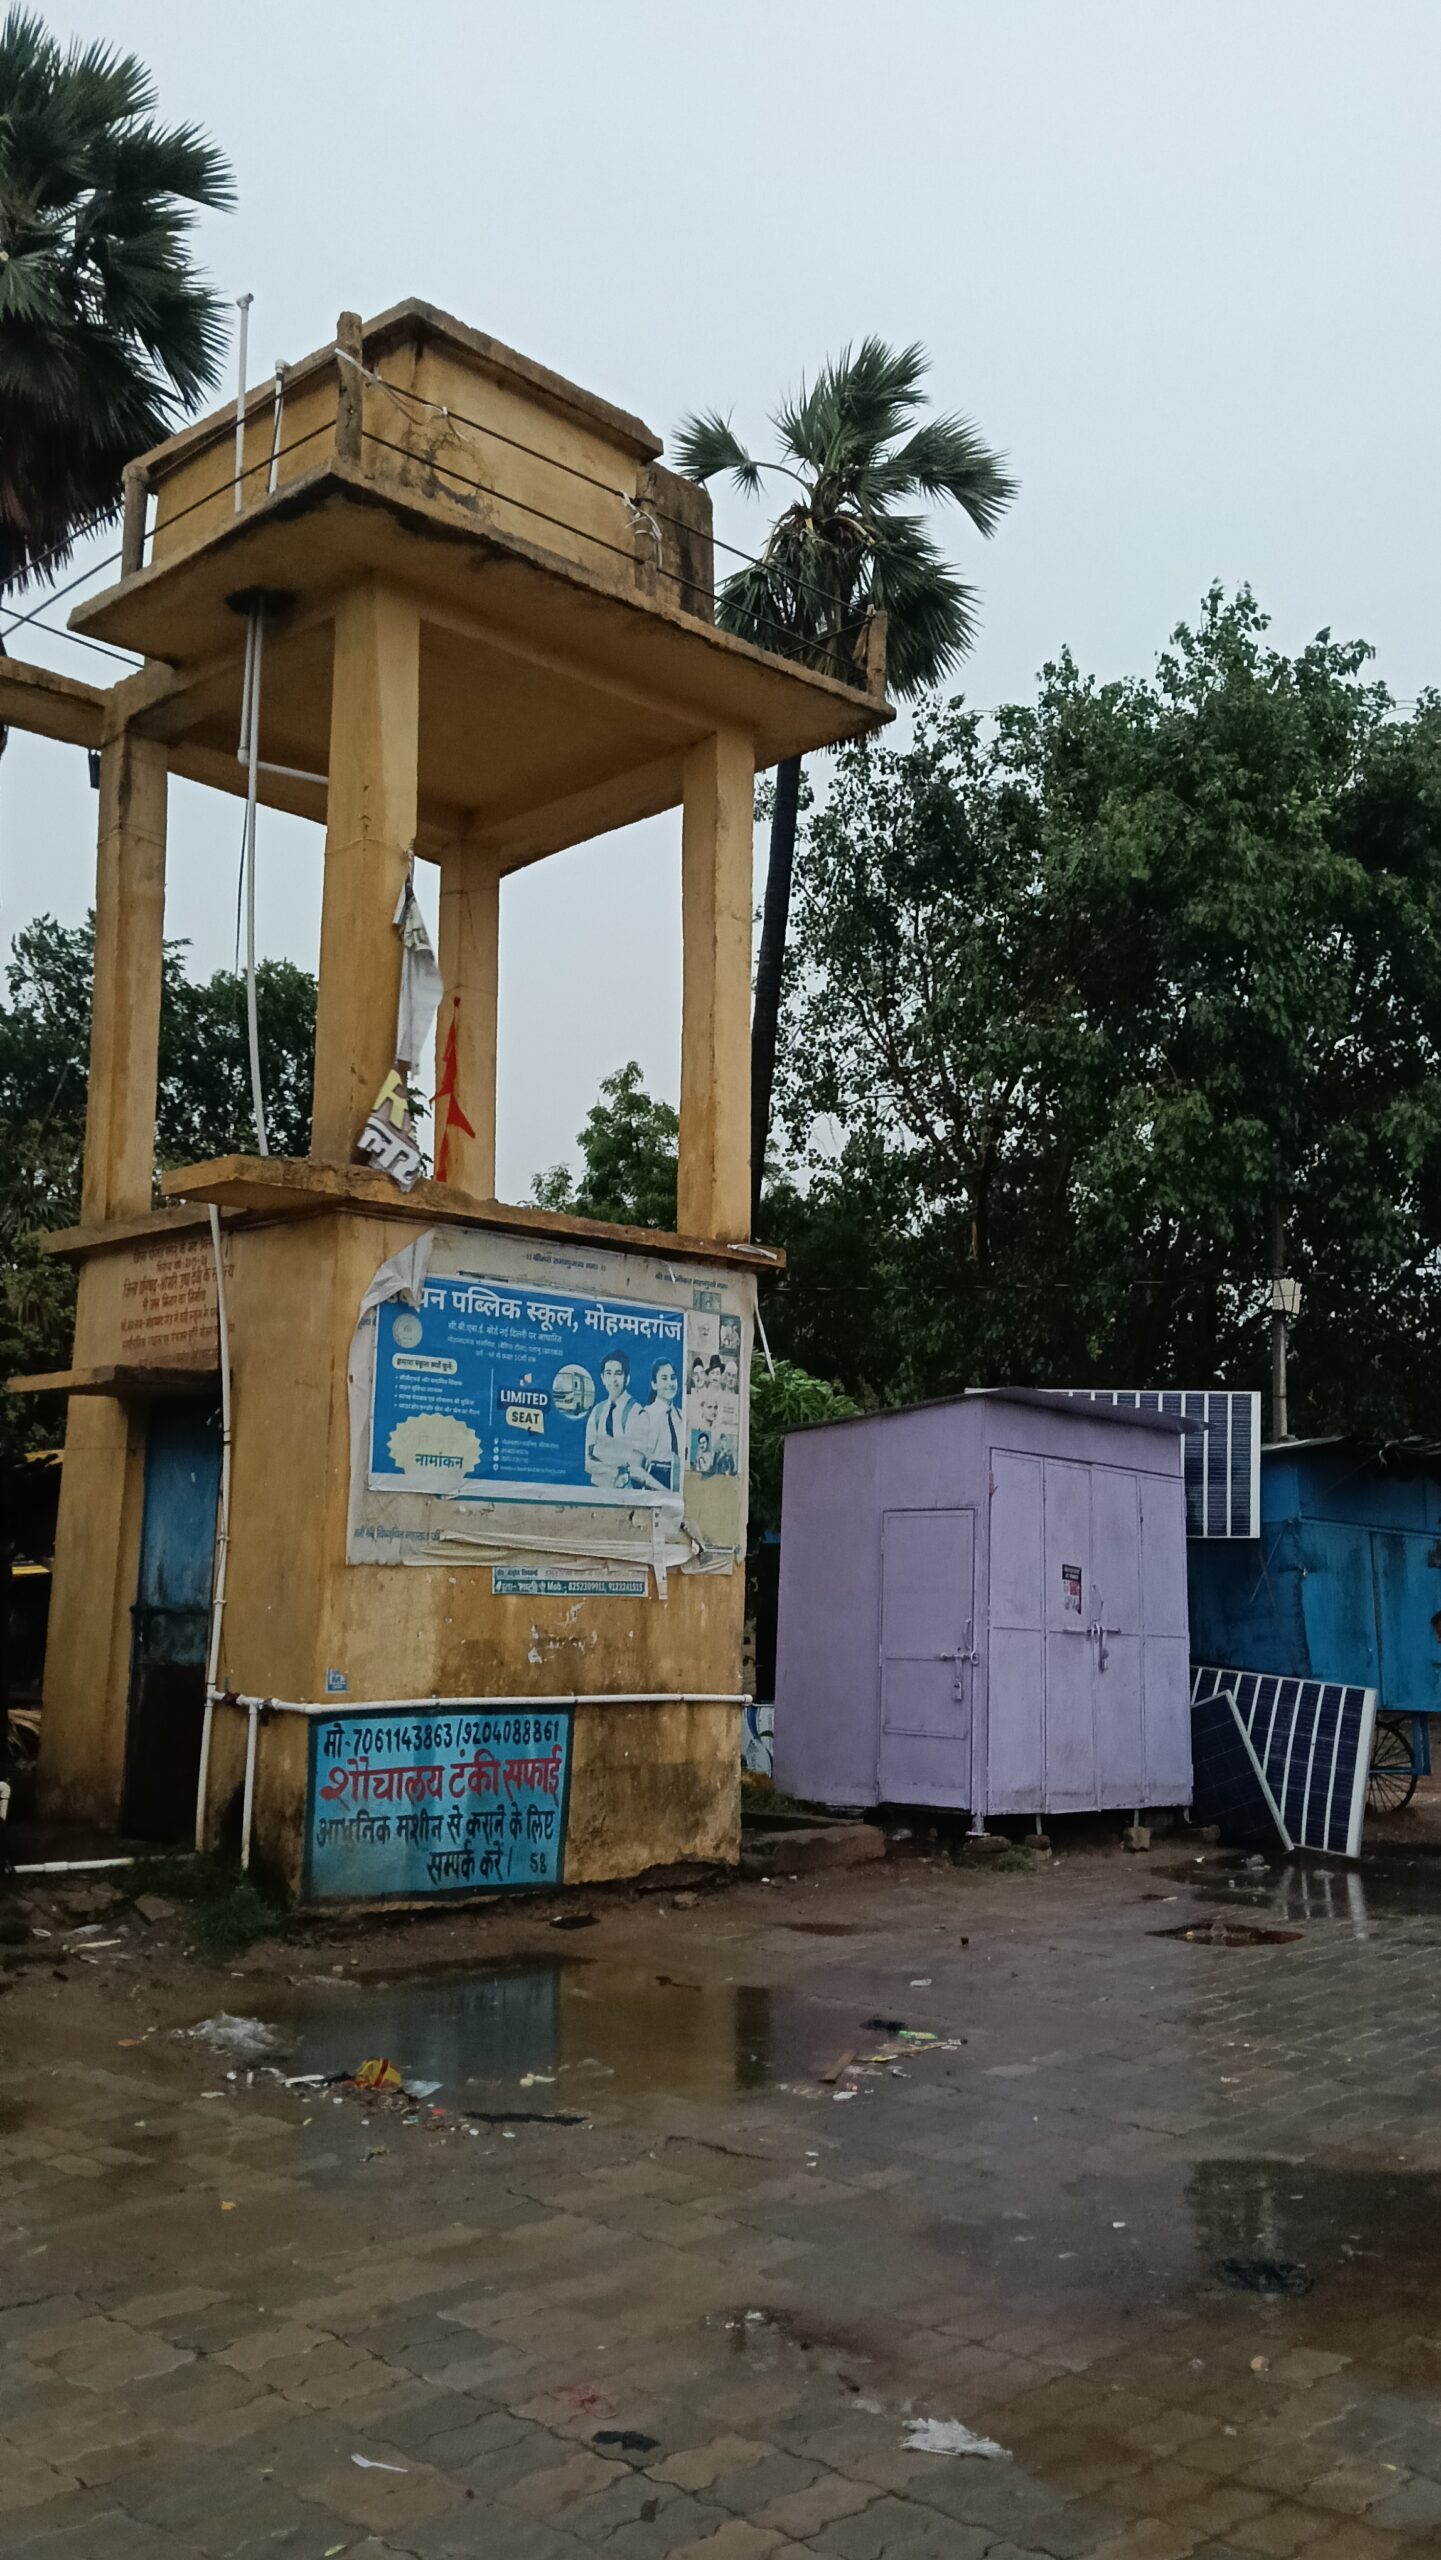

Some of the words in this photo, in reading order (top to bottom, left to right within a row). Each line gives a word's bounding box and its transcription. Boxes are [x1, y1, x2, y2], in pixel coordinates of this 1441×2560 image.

[452, 1286, 522, 1319] पब्लिक
[527, 1301, 579, 1333] स्कूल,
[585, 1304, 682, 1341] मोहम्मदगंज
[500, 1390, 548, 1406] LIMITED
[512, 1411, 540, 1425] SEAT
[415, 1452, 464, 1469] नामांकन
[450, 1749, 500, 1800] टंकी
[503, 1744, 562, 1806] सफाई
[317, 1809, 390, 1847] आधुनिक
[397, 1808, 443, 1846] मशीन
[447, 1805, 463, 1843] से
[466, 1804, 506, 1842] कराने
[509, 1802, 522, 1840] के
[526, 1804, 555, 1841] लिए
[427, 1839, 475, 1884] सम्पर्क
[530, 1852, 547, 1874] 58
